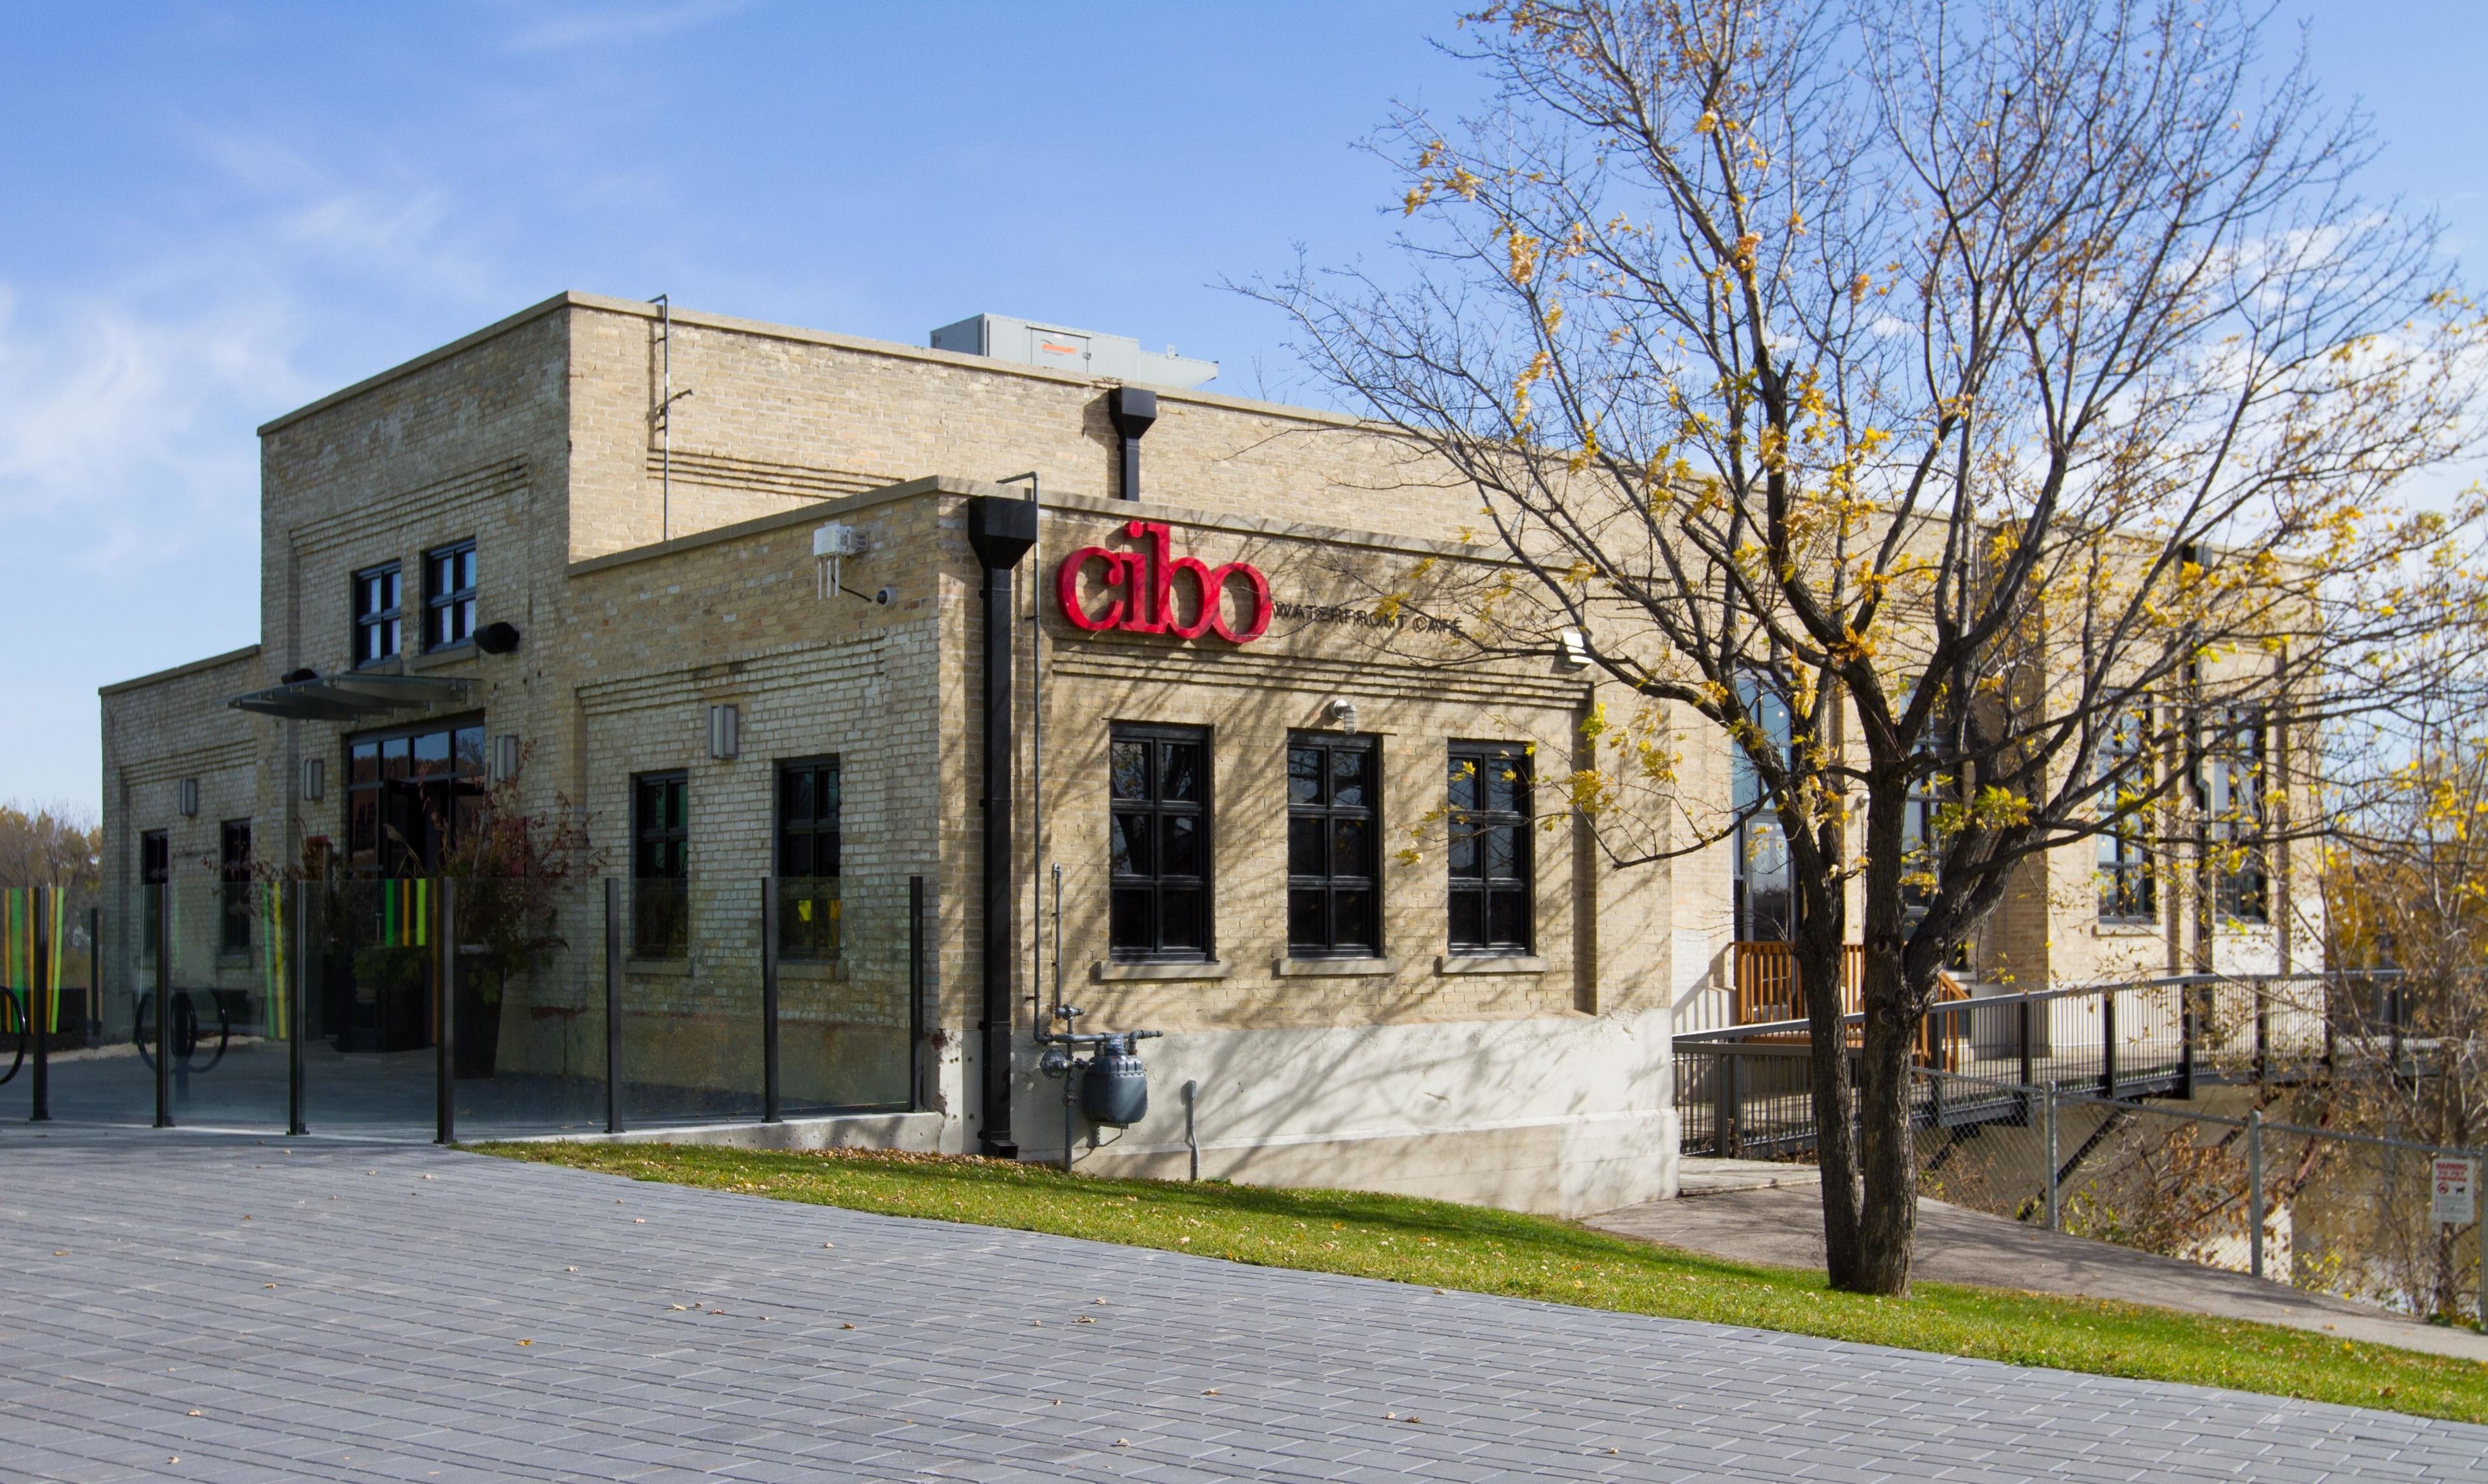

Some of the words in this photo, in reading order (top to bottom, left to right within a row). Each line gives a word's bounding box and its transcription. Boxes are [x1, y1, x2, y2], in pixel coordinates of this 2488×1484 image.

[1057, 520, 1272, 643] cibo
[1273, 601, 1407, 629] WATERFRONT
[2436, 1162, 2467, 1171] WARNING
